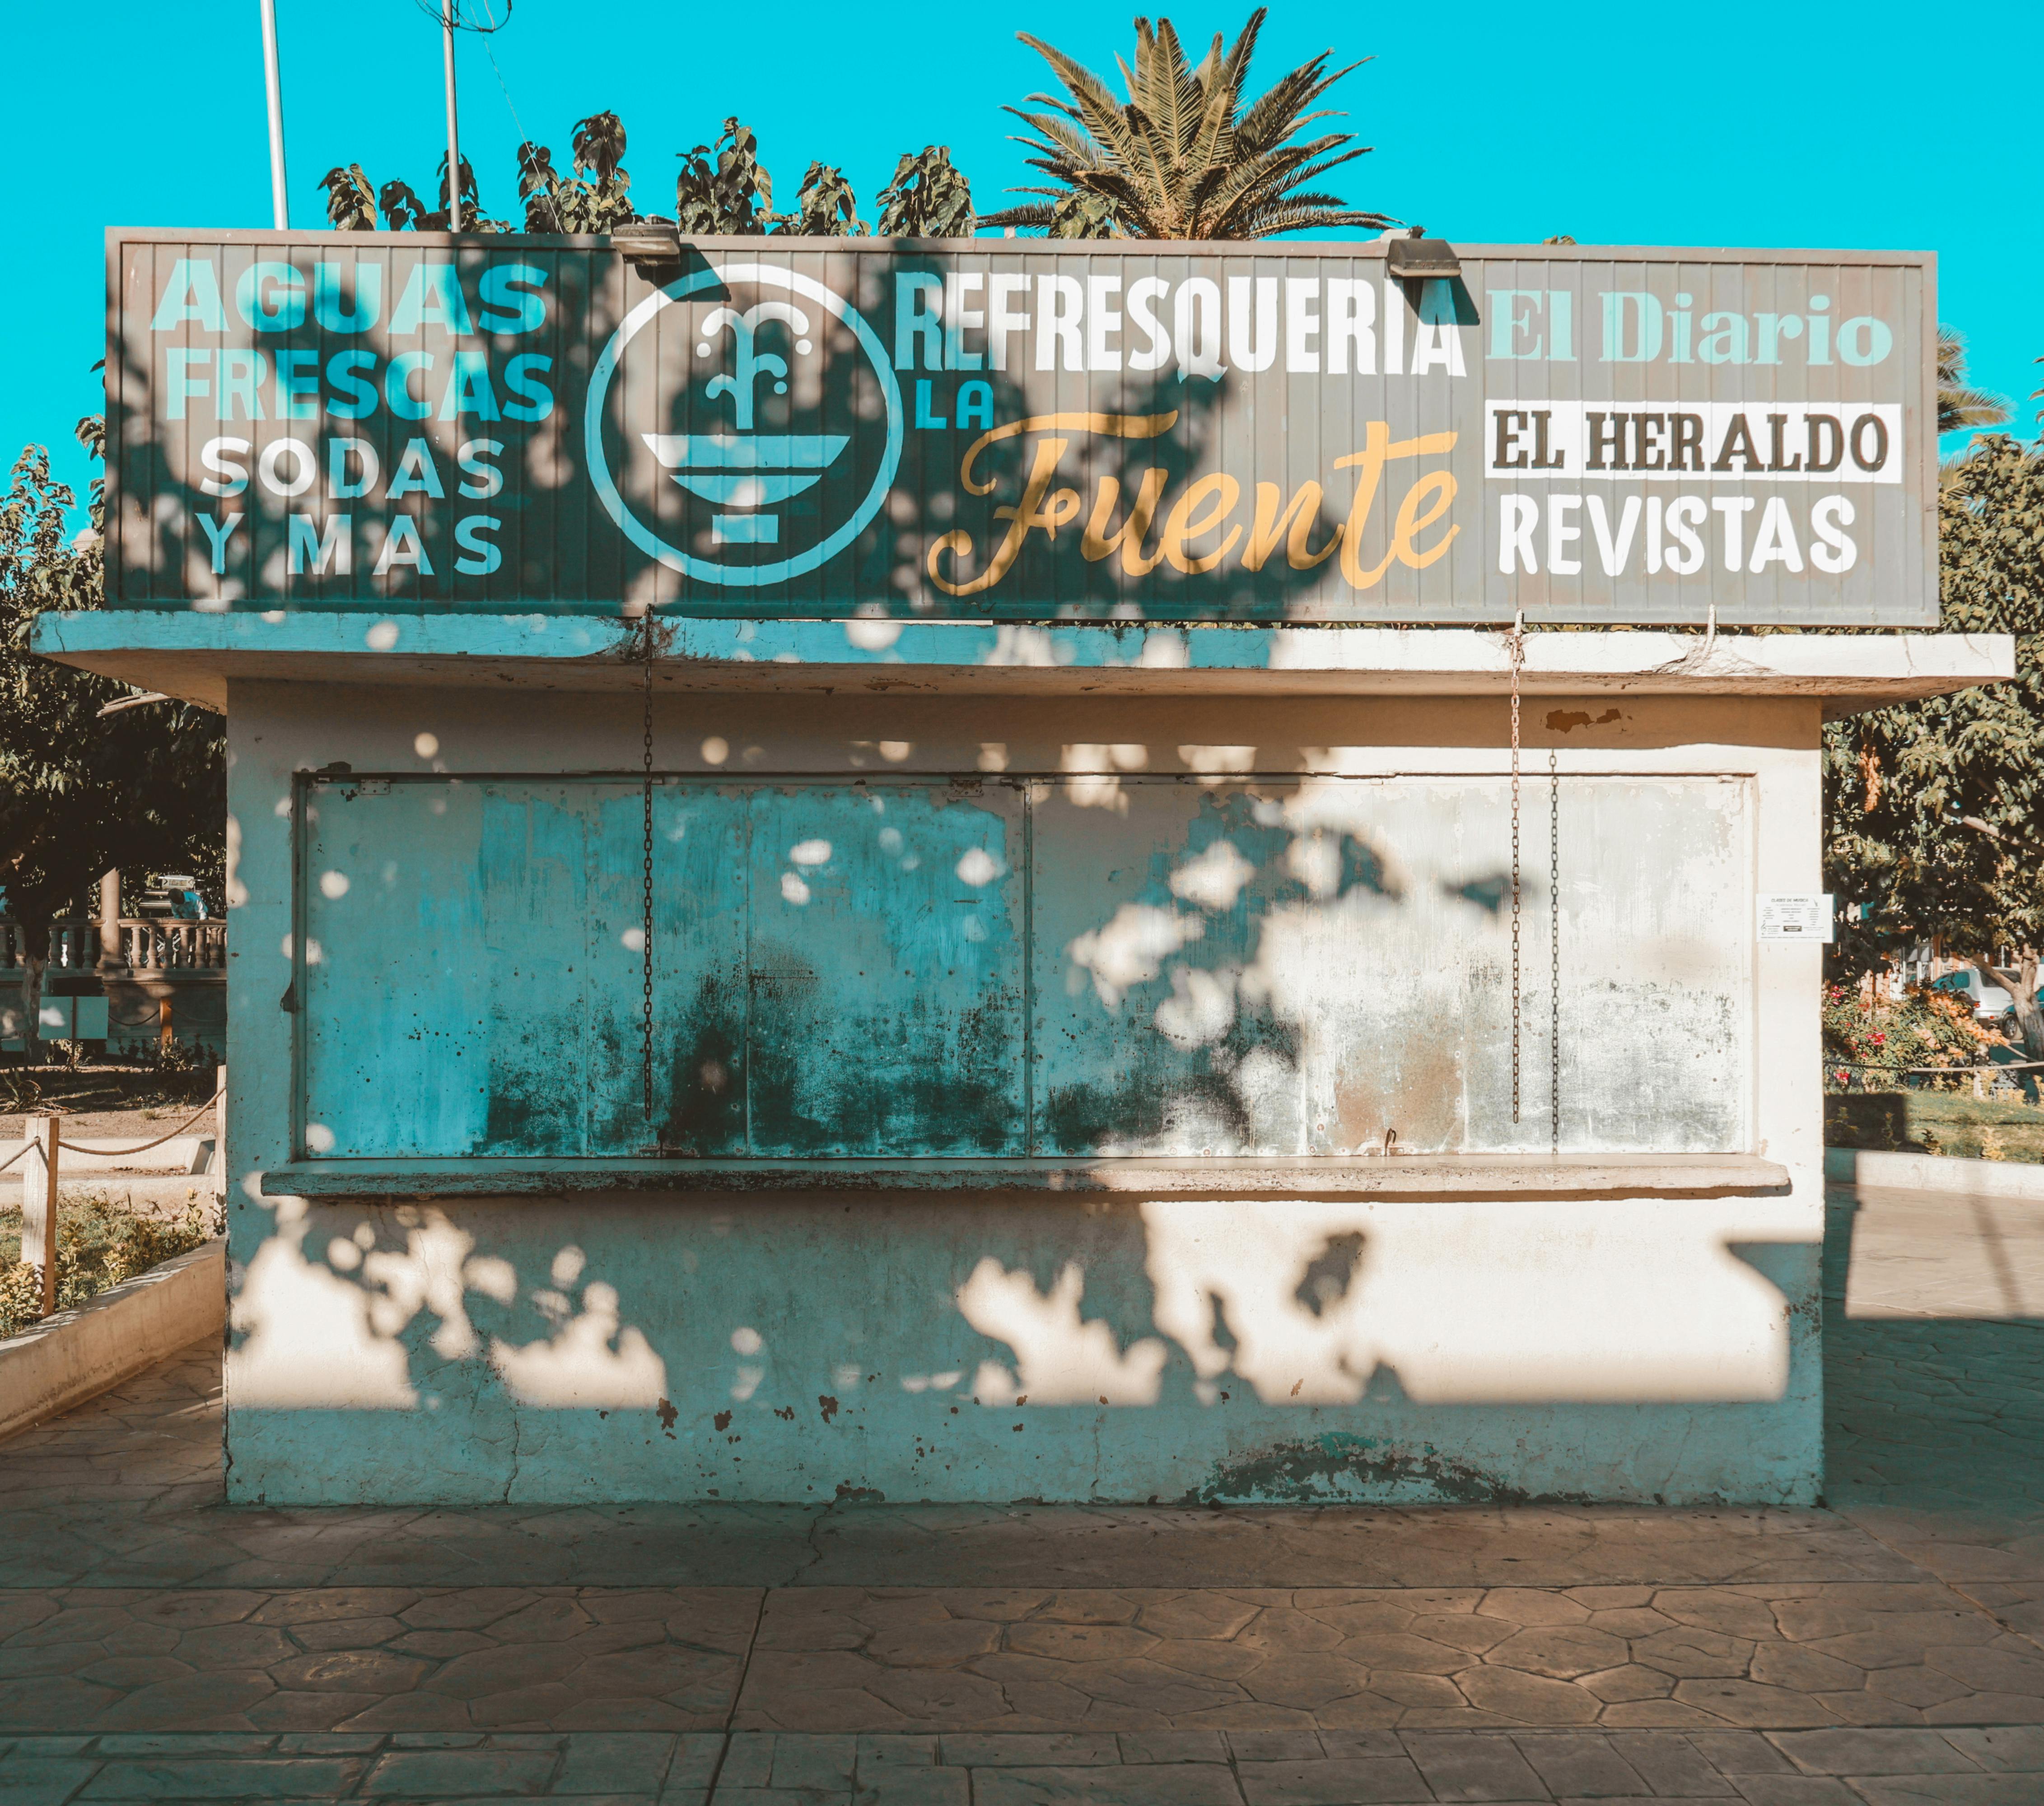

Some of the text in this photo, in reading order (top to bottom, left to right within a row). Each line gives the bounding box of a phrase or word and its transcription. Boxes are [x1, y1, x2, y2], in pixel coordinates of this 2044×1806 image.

[149, 259, 548, 335] AGUAS
[895, 272, 1467, 384] REFRESQUERIA
[1485, 289, 1893, 366] El Diario
[166, 348, 554, 422] FRESCAS
[915, 379, 993, 429] LA
[199, 436, 505, 499] SODAS
[1493, 410, 1889, 473] EL HERALDO
[927, 410, 1460, 596] Fuente
[1499, 494, 1857, 577] REVISTAS
[195, 512, 502, 575] Y MAS
